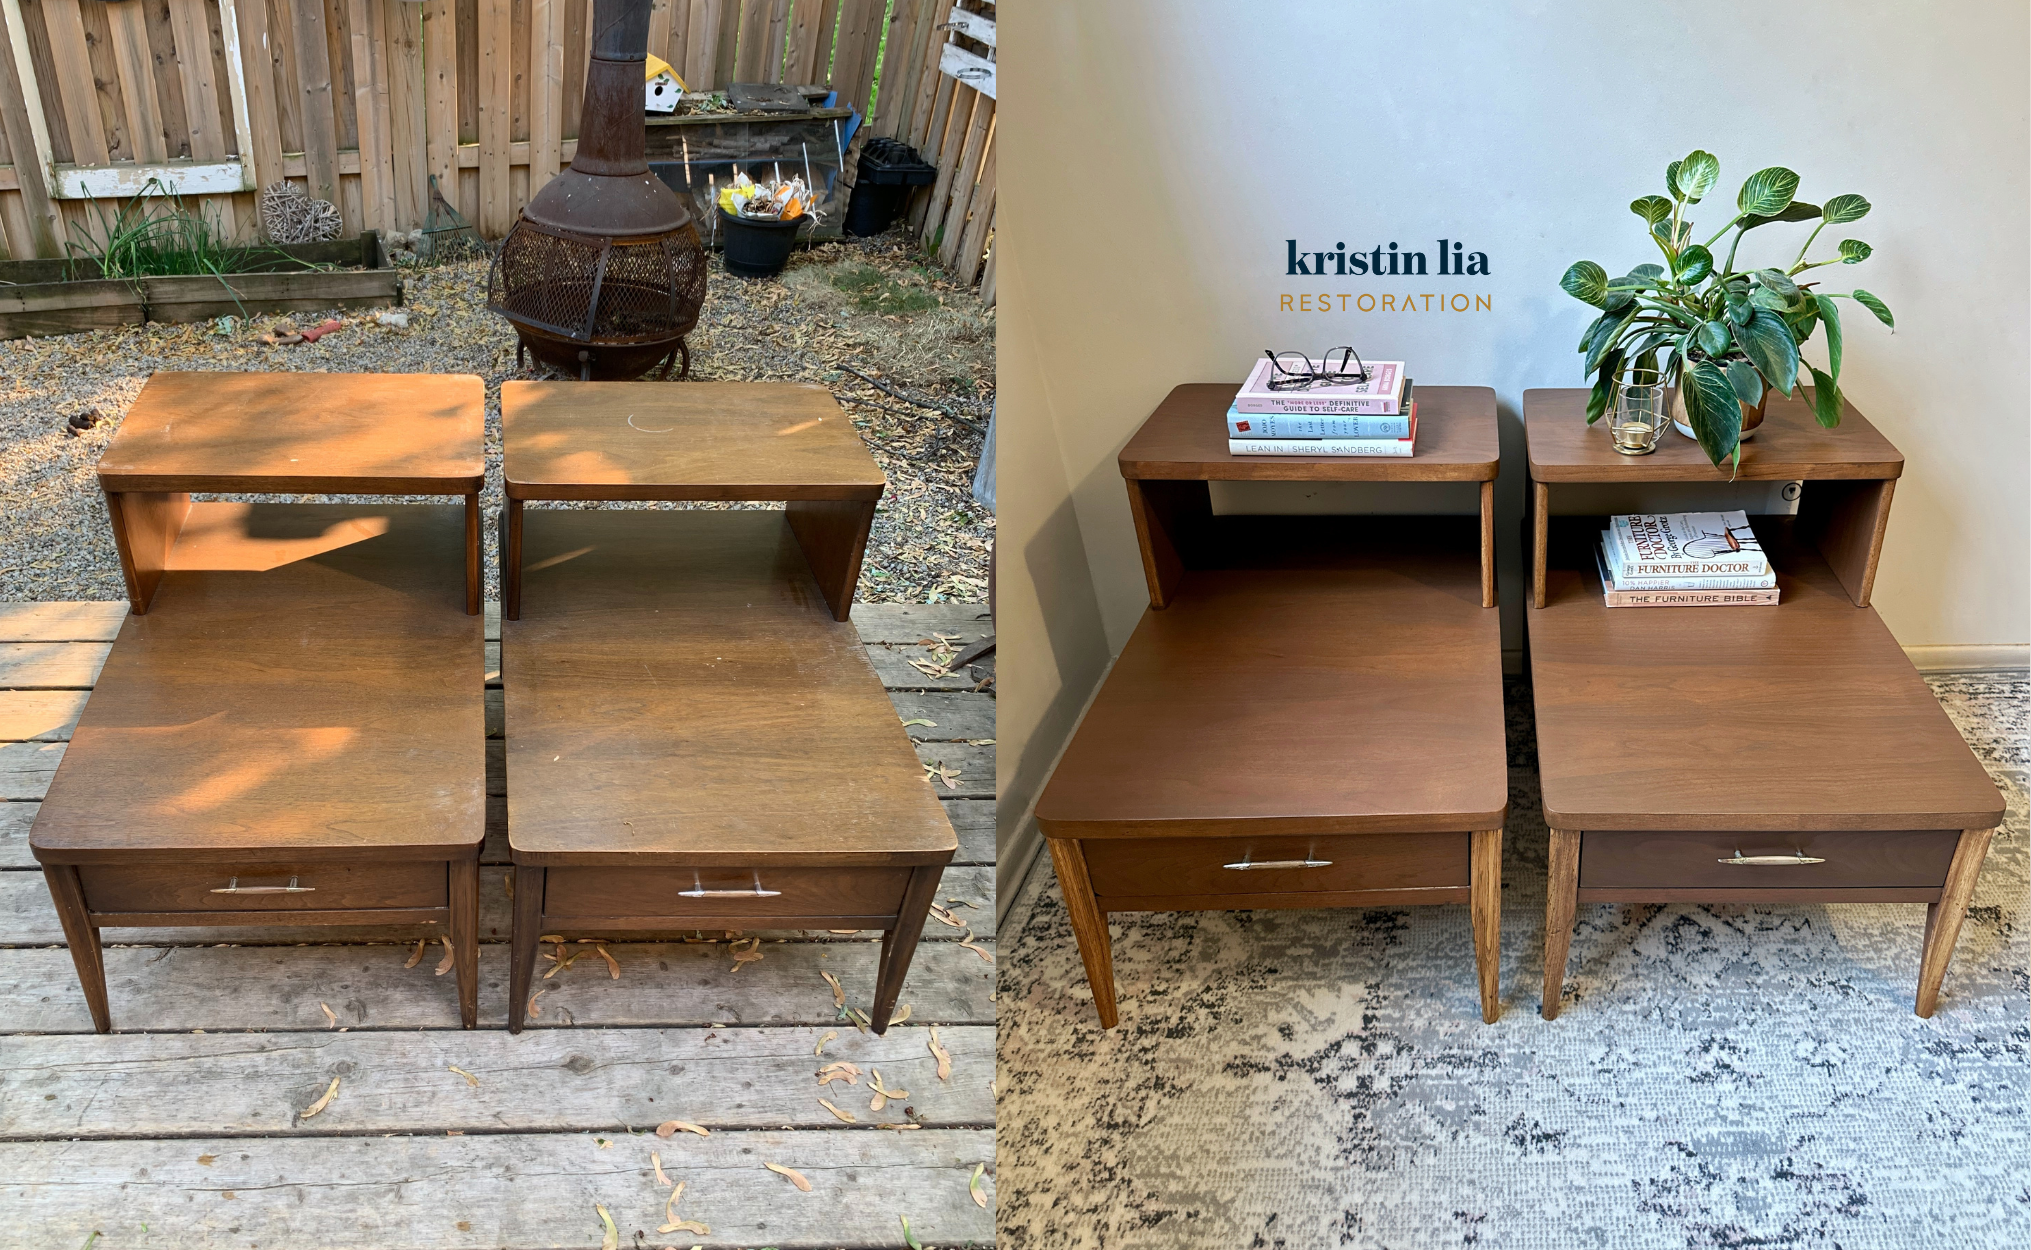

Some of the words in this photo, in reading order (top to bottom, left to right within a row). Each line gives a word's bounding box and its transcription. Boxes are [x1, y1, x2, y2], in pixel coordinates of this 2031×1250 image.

[1332, 446, 1382, 454] SANDBERG
[1660, 516, 1671, 533] Grotz
[1628, 515, 1655, 560] FURNITURE
[1644, 514, 1668, 560] DOCTOR
[1665, 534, 1679, 552] George
[1638, 564, 1699, 573] FURNITURE
[1702, 564, 1749, 572] DOCTOR
[1656, 595, 1719, 603] FURNITURE
